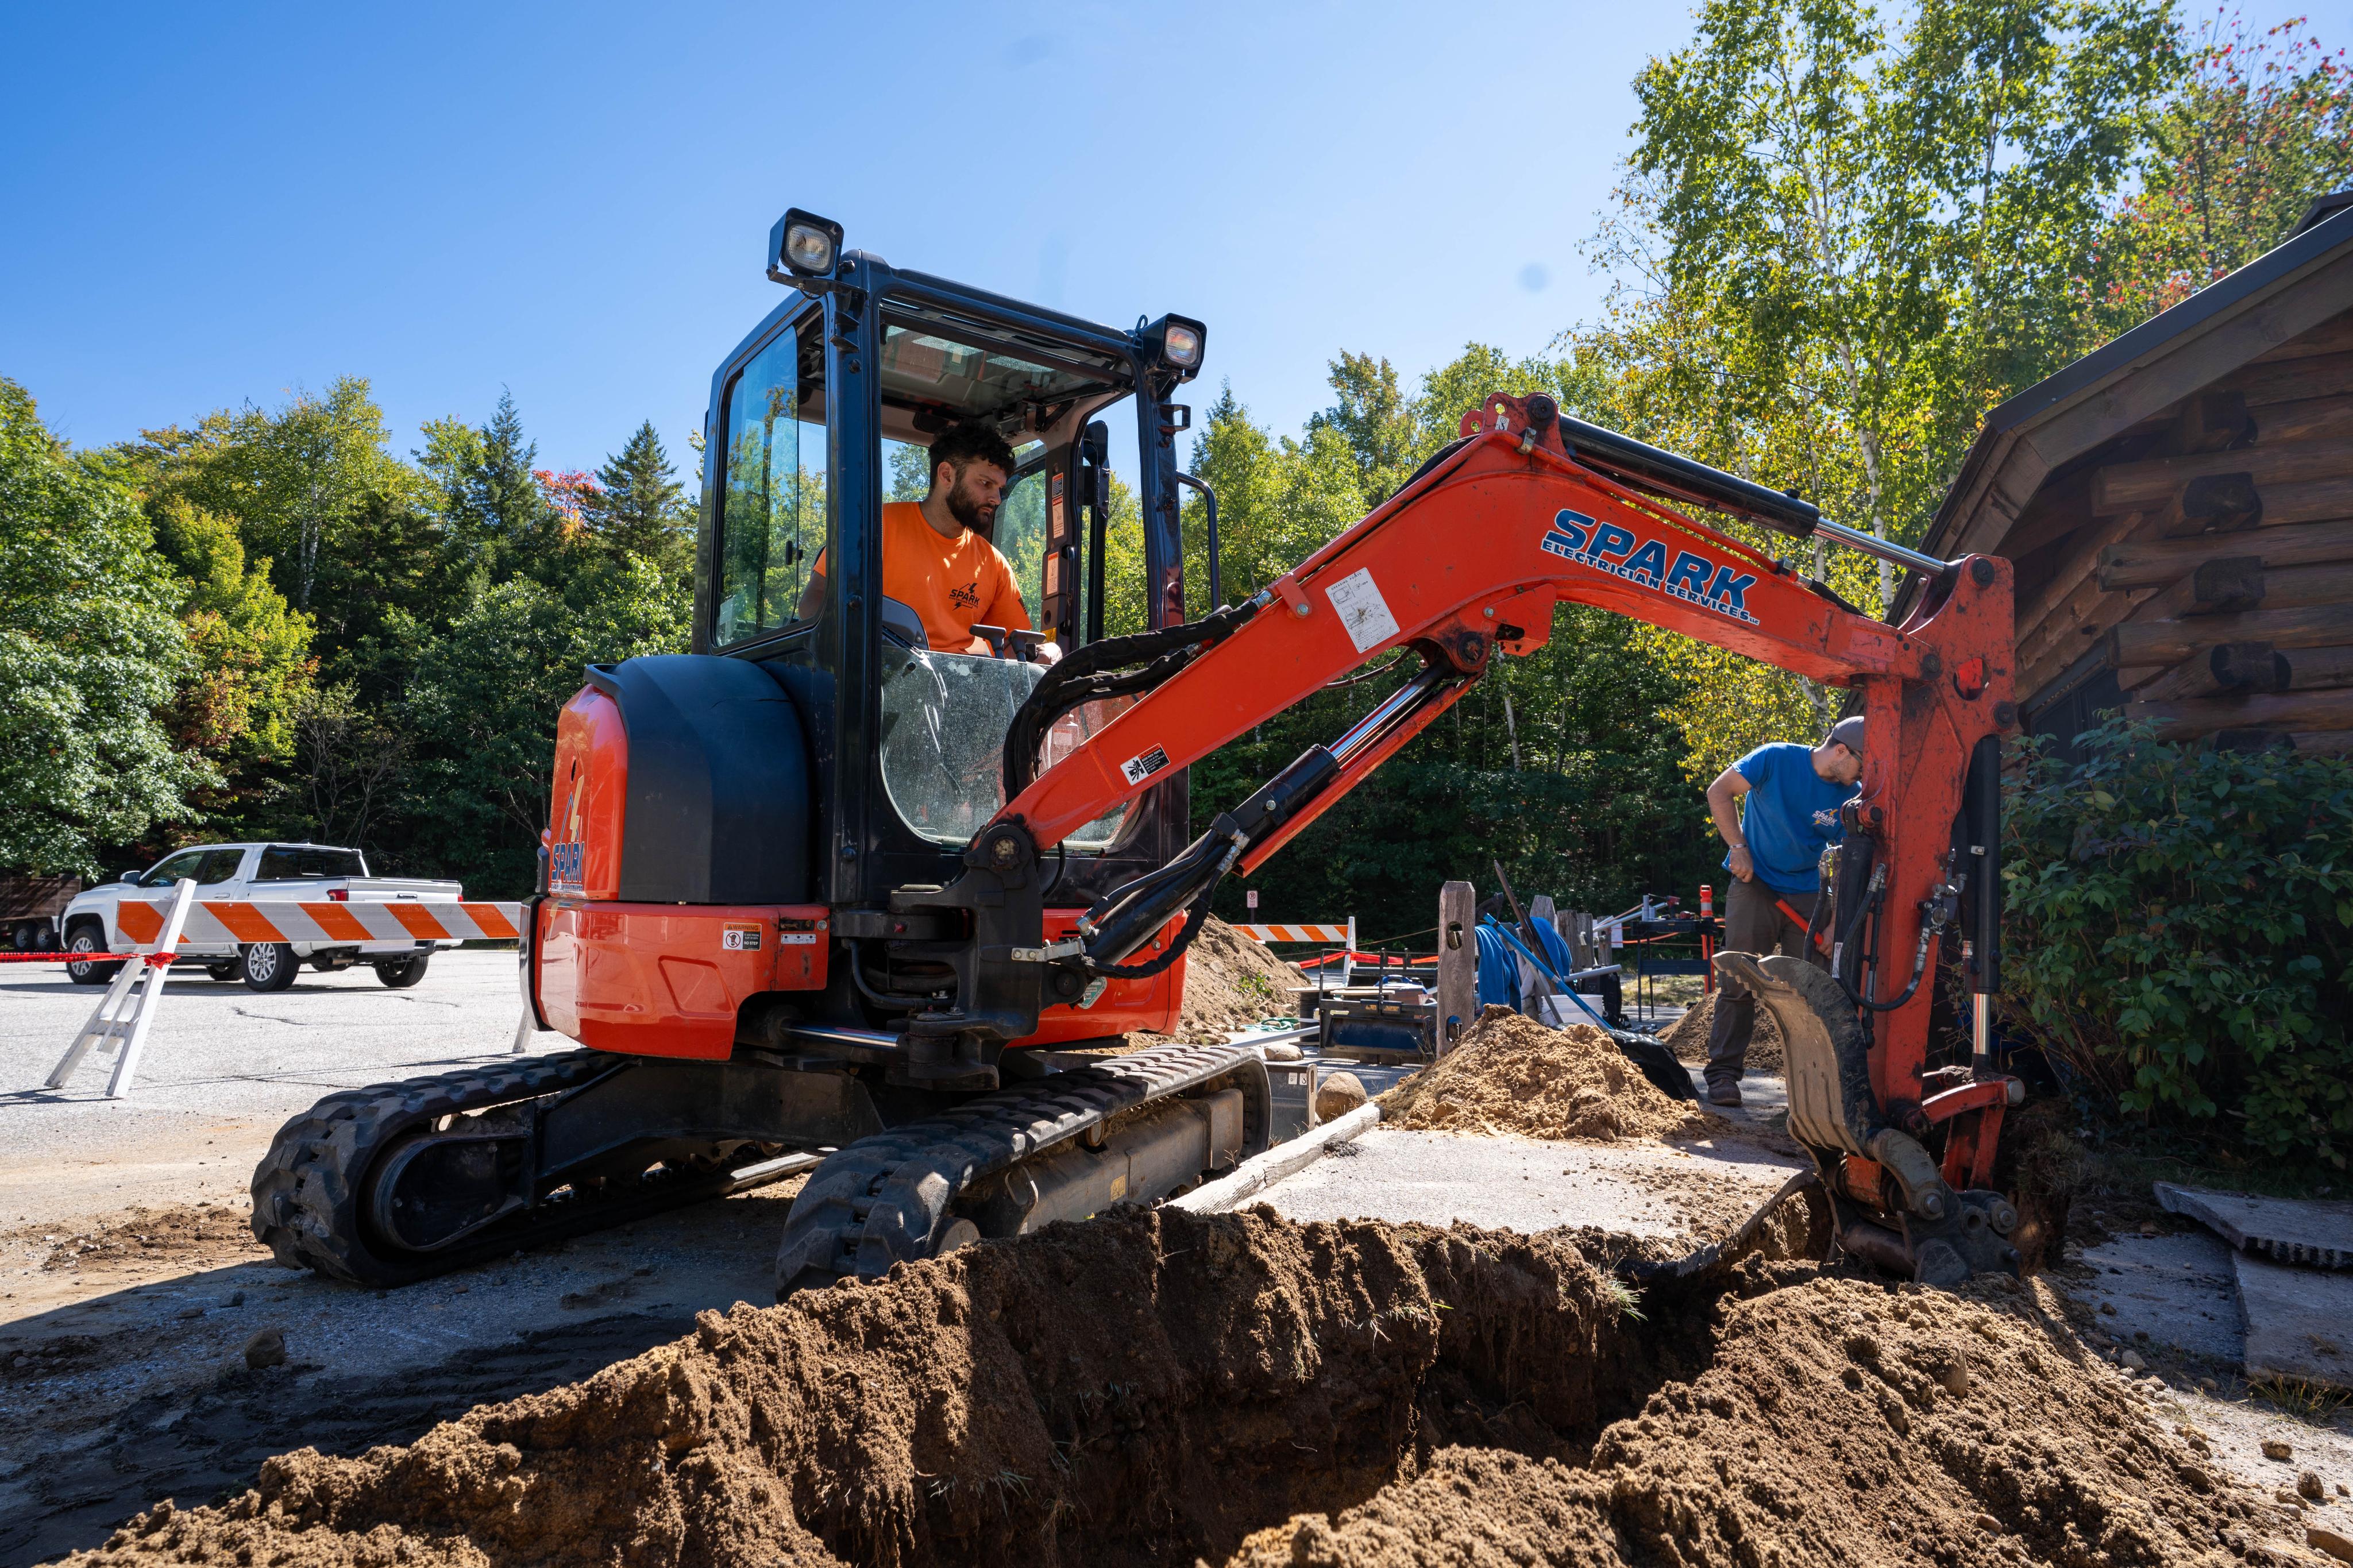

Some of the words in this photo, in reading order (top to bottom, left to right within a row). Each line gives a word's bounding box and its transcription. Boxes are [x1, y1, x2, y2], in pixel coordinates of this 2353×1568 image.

[1541, 538, 1661, 590] ELECTRICIAN
[1664, 583, 1750, 621] SERVICES
[1749, 617, 1760, 625] LLC
[1545, 508, 1758, 609] SPARK
[949, 589, 980, 605] SPARK
[1813, 810, 1838, 824] SPARK
